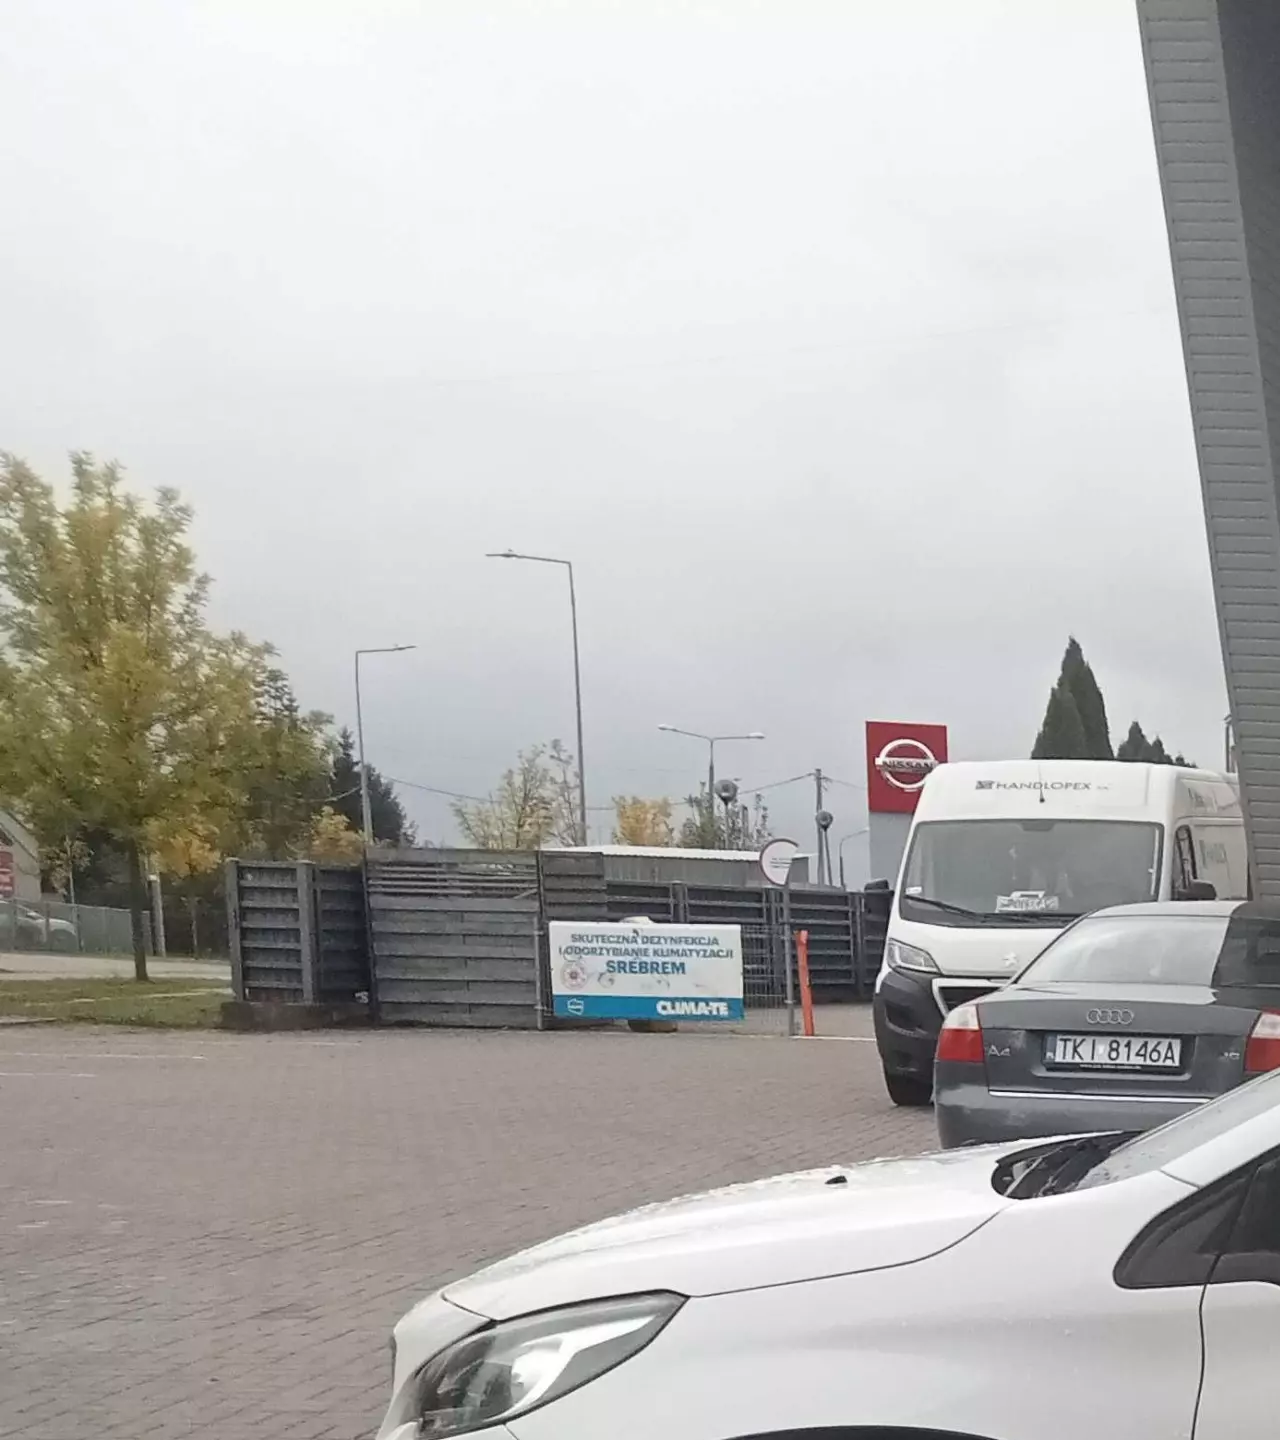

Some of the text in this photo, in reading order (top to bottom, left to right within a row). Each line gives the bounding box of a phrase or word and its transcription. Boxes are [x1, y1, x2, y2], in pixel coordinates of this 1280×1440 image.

[882, 760, 933, 770] NISSAN
[995, 782, 1092, 791] HANDLOPEX
[571, 934, 719, 946] SKUTECZNA DEZYNFEKCJA
[566, 946, 650, 957] ODGRZYBIANIE
[653, 948, 733, 958] KLIMATYZACJI
[606, 960, 687, 975] SREBREM
[1059, 1038, 1176, 1064] TKI 8146A
